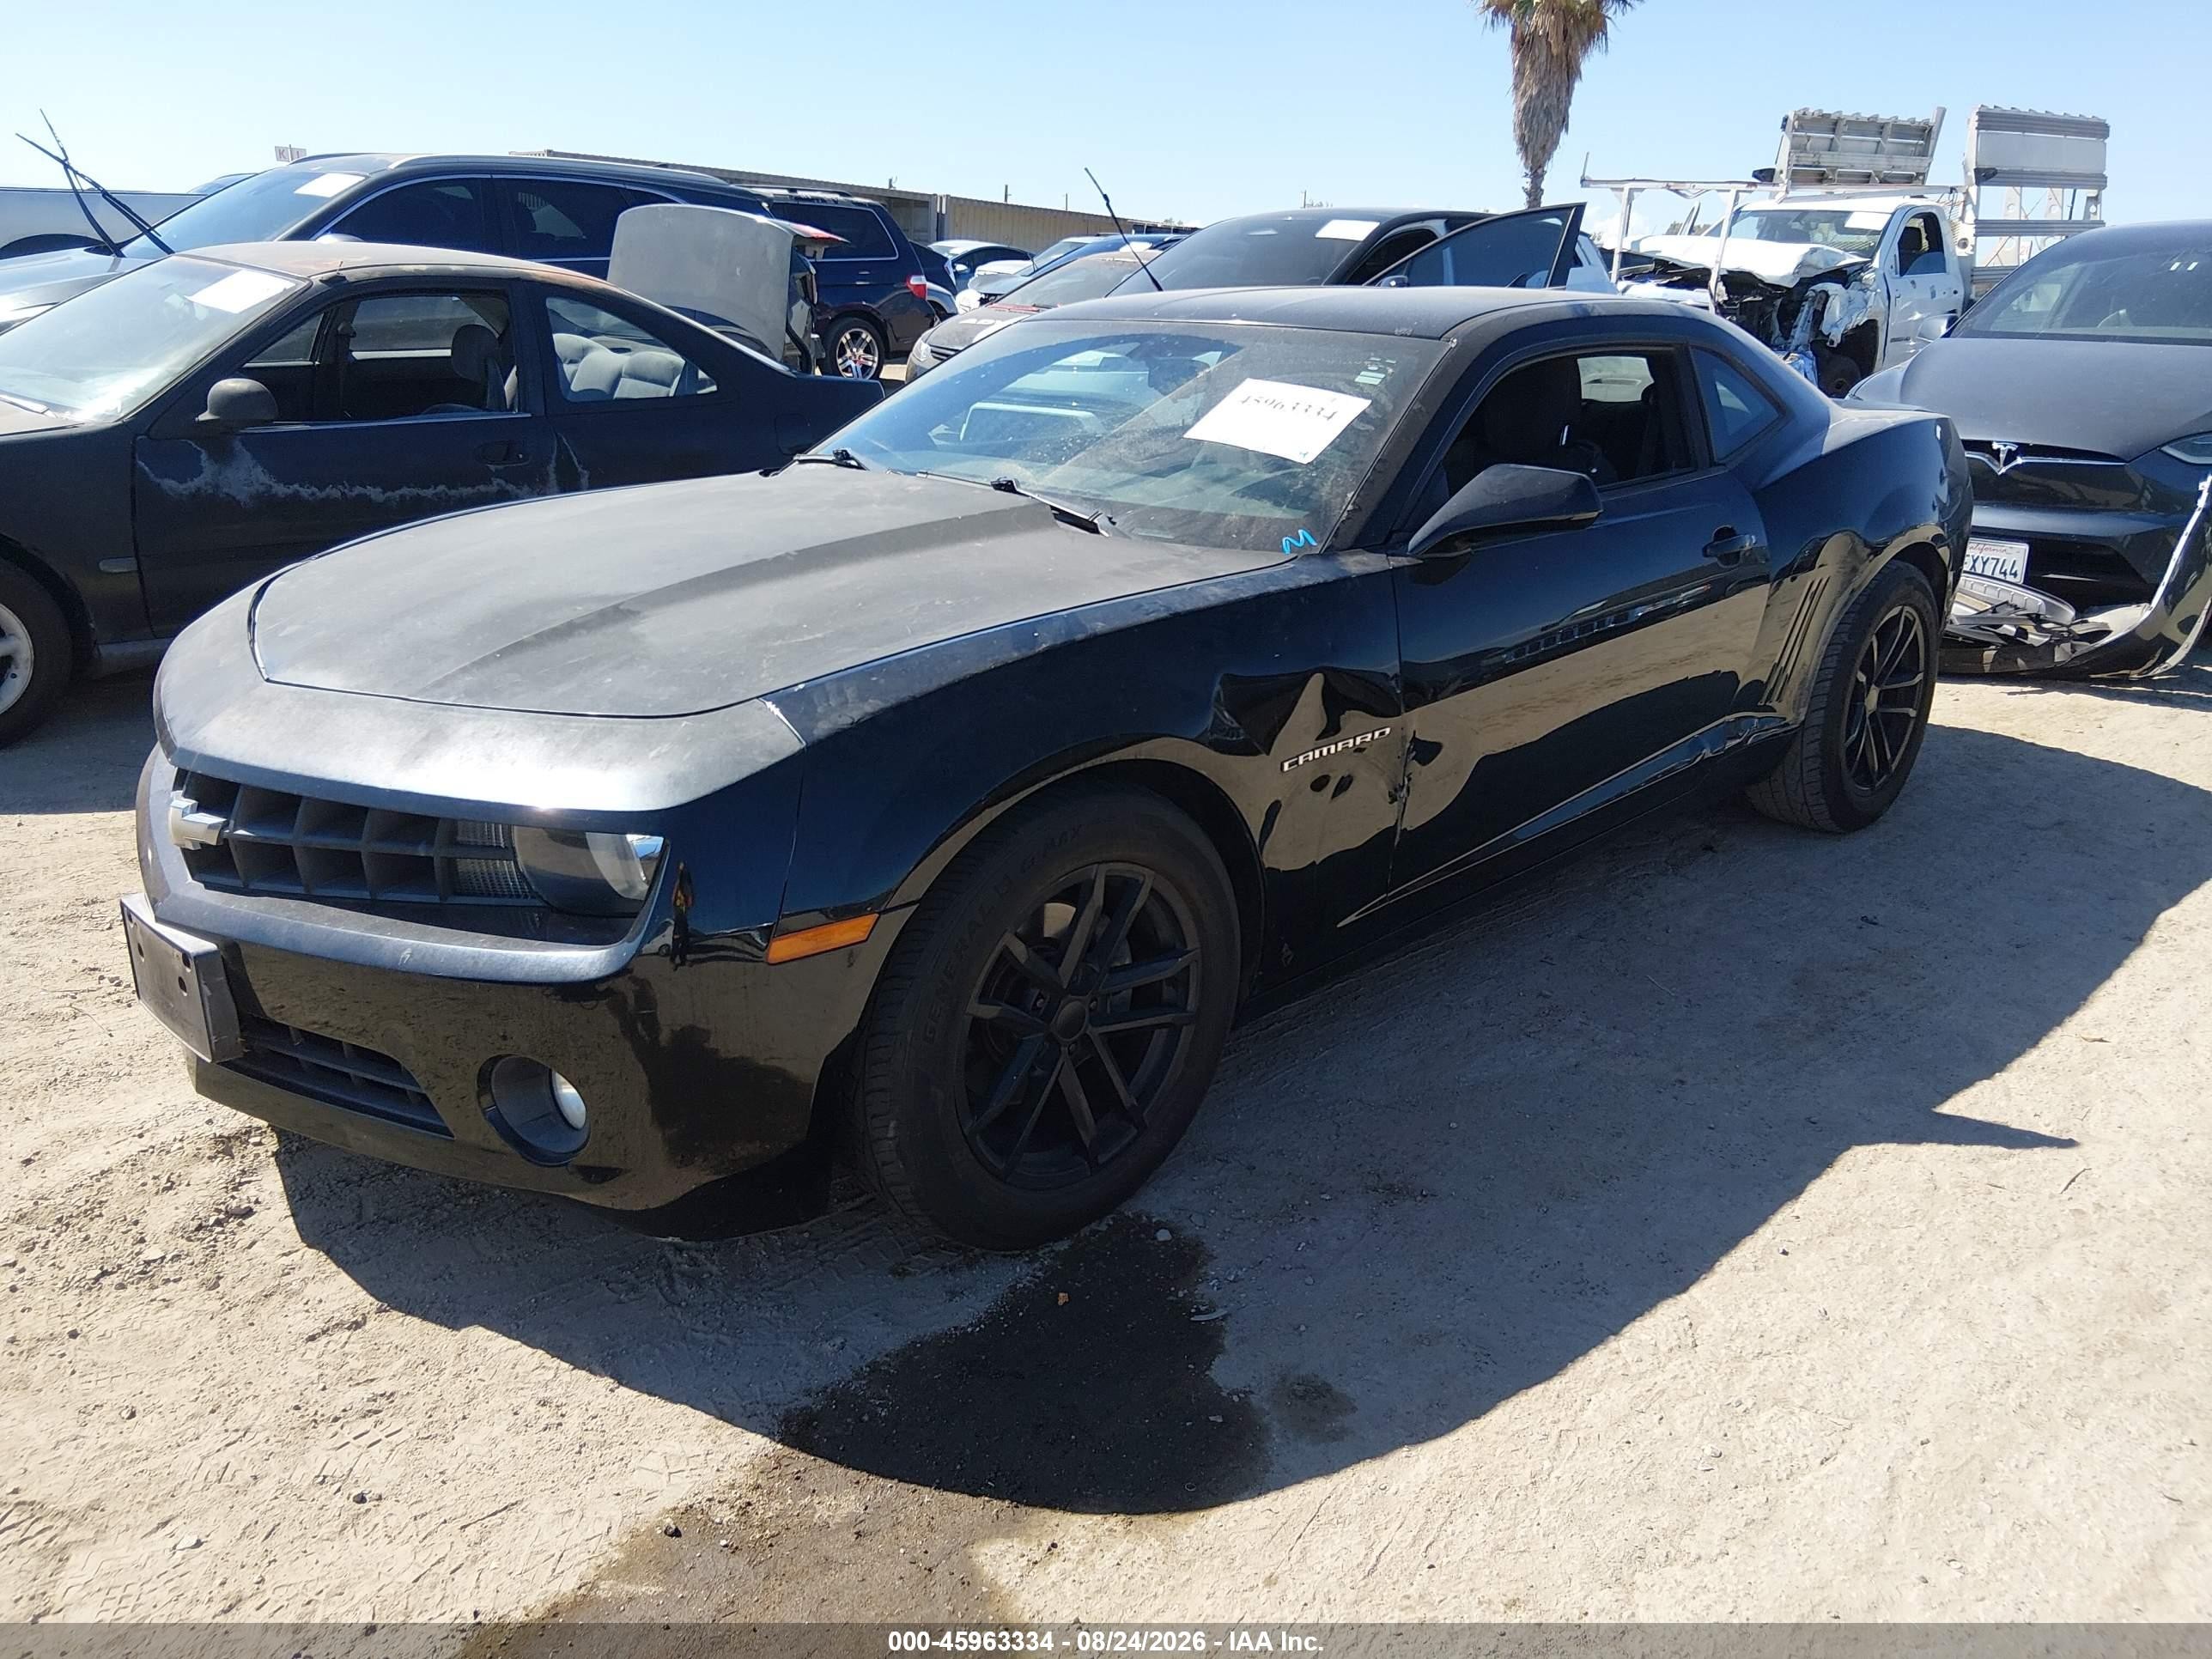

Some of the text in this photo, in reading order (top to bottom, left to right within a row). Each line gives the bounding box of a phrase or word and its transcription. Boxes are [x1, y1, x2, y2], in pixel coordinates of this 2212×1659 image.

[278, 149, 288, 160] K
[1969, 543, 2008, 555] alifornia
[1280, 726, 1392, 773] CAMARO
